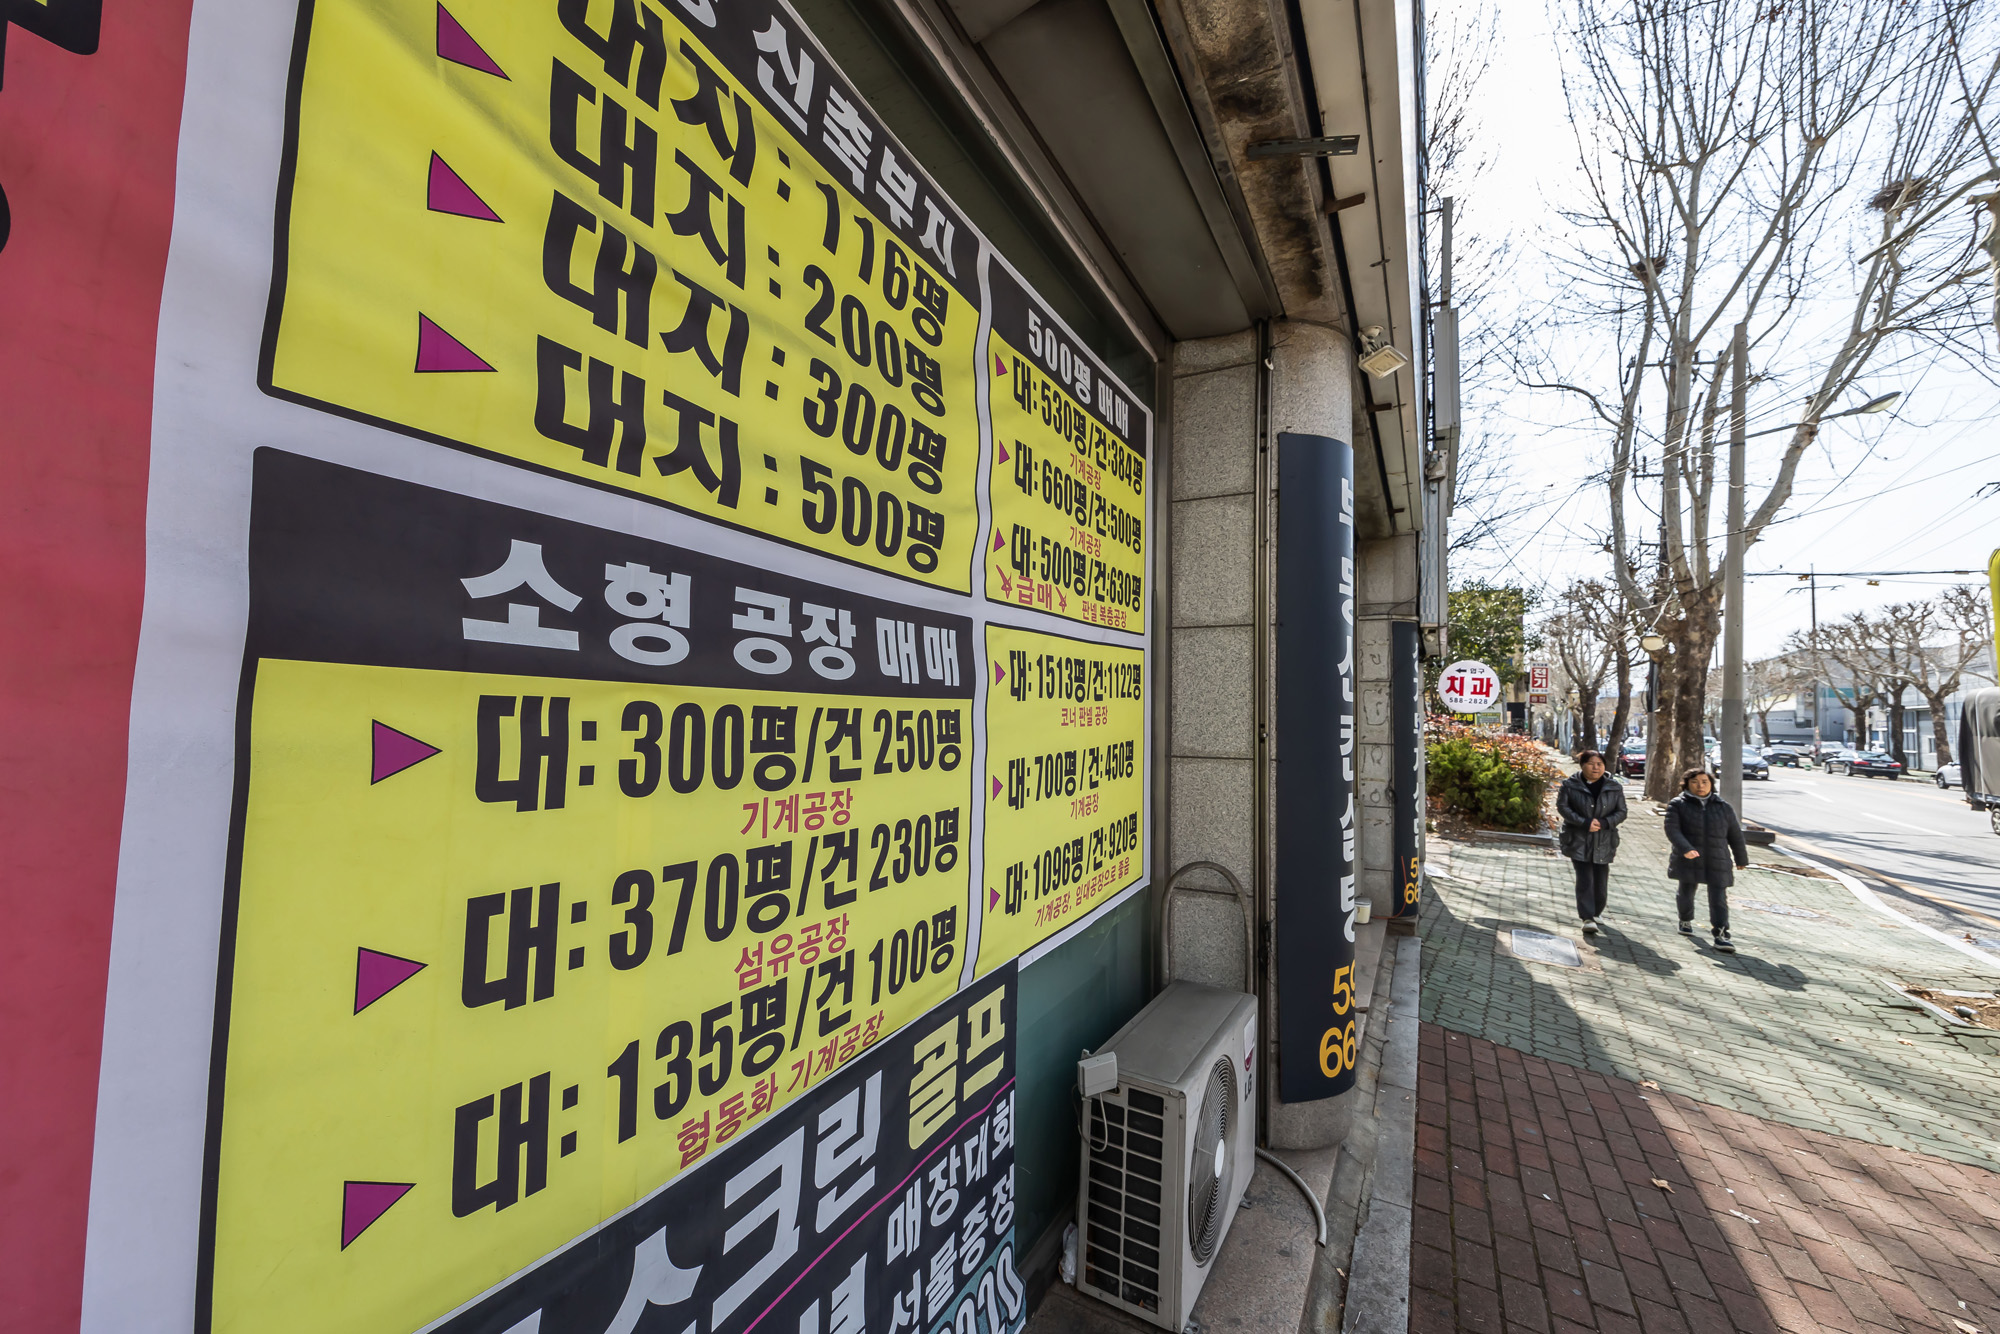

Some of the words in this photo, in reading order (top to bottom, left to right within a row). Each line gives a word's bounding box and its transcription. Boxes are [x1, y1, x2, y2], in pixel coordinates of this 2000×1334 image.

[1028, 308, 1092, 405] 500평
[1098, 377, 1129, 439] 매매
[1069, 452, 1102, 491] 기계공장
[1069, 525, 1102, 559] 기계공장
[460, 538, 691, 666] 소형
[732, 586, 857, 681] 공장
[875, 617, 961, 687] 매매
[1016, 574, 1053, 612] 급매
[1445, 675, 1493, 698] 치과
[1449, 697, 1488, 705] 588-2828
[1533, 668, 1547, 688] 전기
[873, 708, 962, 775] 250평
[1061, 706, 1077, 728] 코너
[1079, 706, 1093, 727] 판넬
[1094, 705, 1108, 726] 공장
[740, 787, 854, 839] 기계공장
[1070, 791, 1099, 820] 기계공장
[869, 806, 960, 892] 230평
[1034, 890, 1072, 928] 기계공장,
[1075, 864, 1117, 907] 임대공장으로
[733, 912, 850, 991] 섬유공장
[868, 904, 957, 1006] 100평
[908, 983, 1006, 1150] 골프
[1319, 1020, 1356, 1078] 66
[676, 1072, 779, 1170] 협동화
[786, 1009, 885, 1093] 기계공장
[1244, 1073, 1252, 1102] LG
